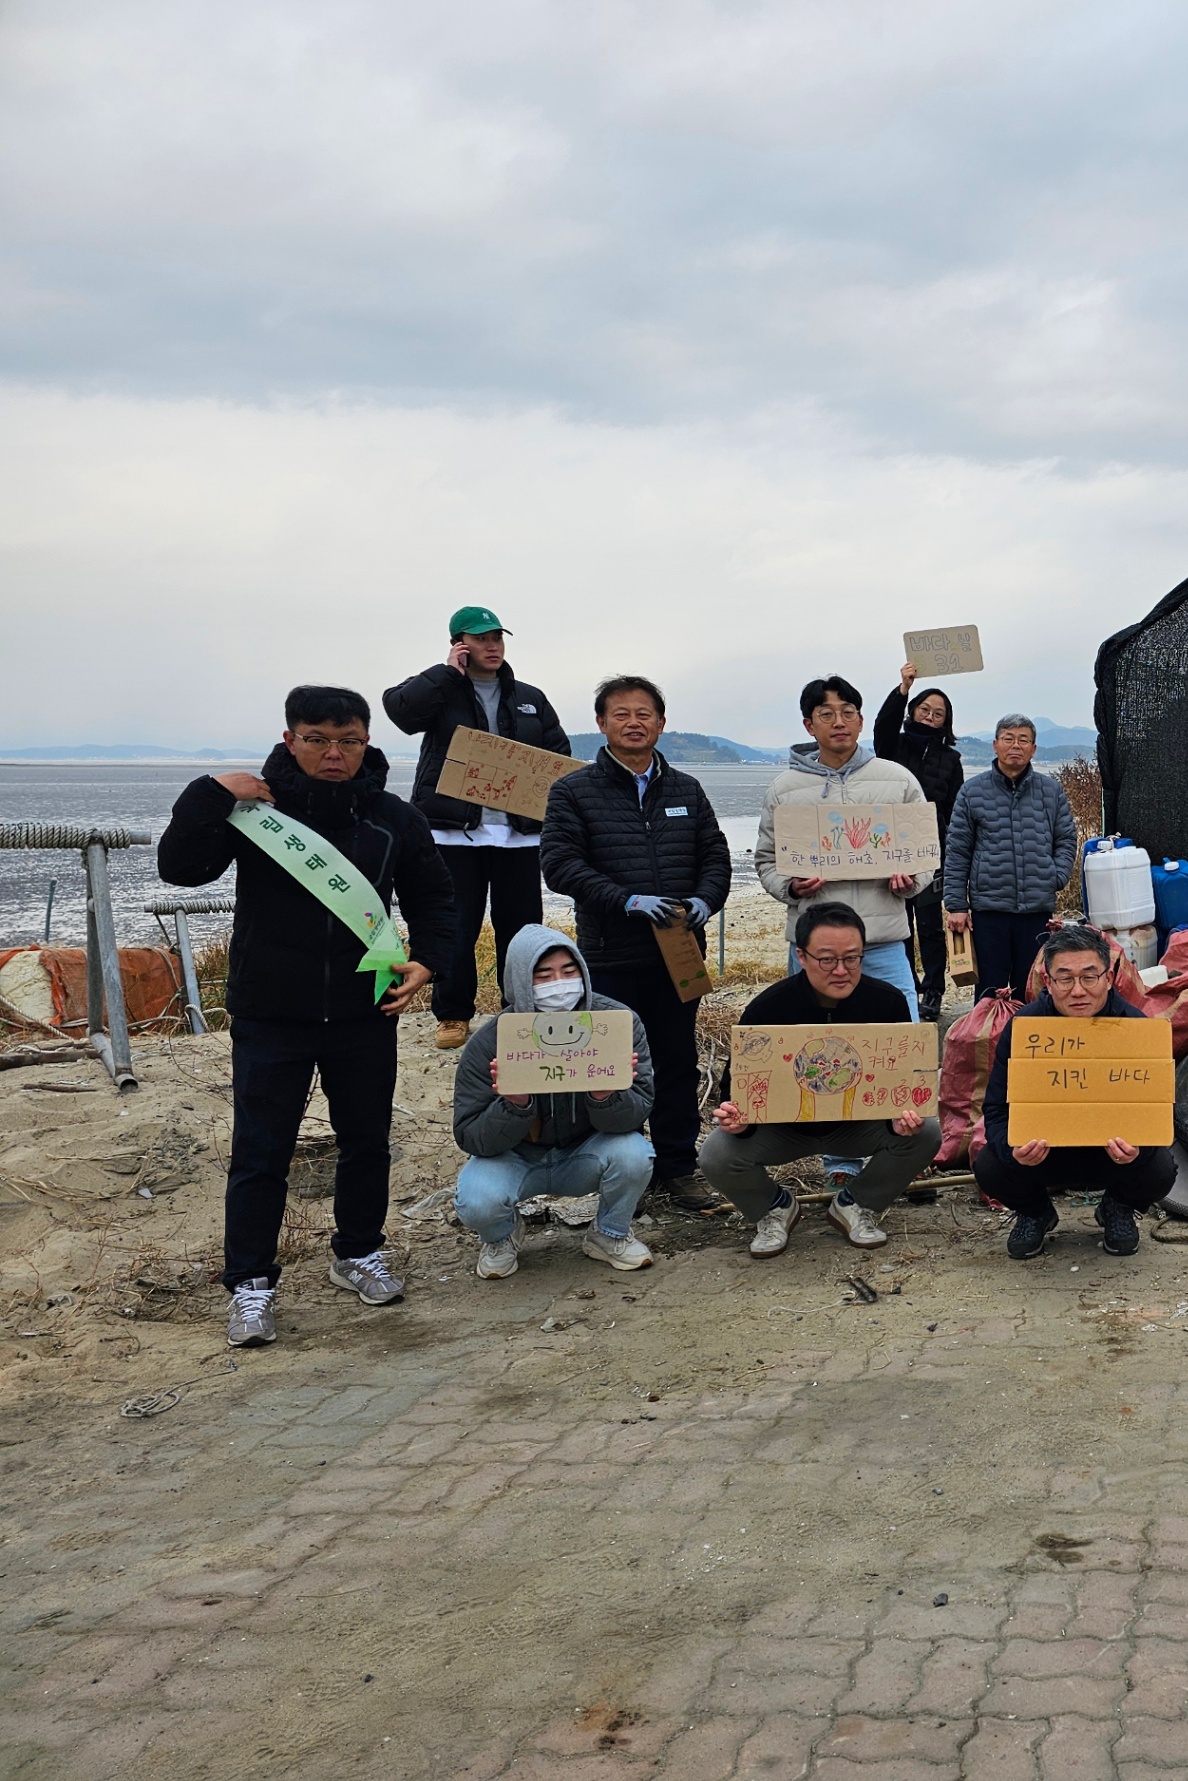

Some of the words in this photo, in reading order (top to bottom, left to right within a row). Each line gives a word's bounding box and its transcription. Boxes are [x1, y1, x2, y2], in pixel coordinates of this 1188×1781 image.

[809, 854, 841, 868] 뿌리의
[881, 848, 914, 864] 지구를
[506, 1051, 546, 1061] 바다가
[560, 1048, 600, 1061] 살아야
[1025, 1034, 1086, 1059] 우리가
[868, 1055, 898, 1071] 켜요
[539, 1065, 578, 1081] 지구가
[1047, 1068, 1089, 1089] 지킨
[1109, 1068, 1151, 1084] 바다
